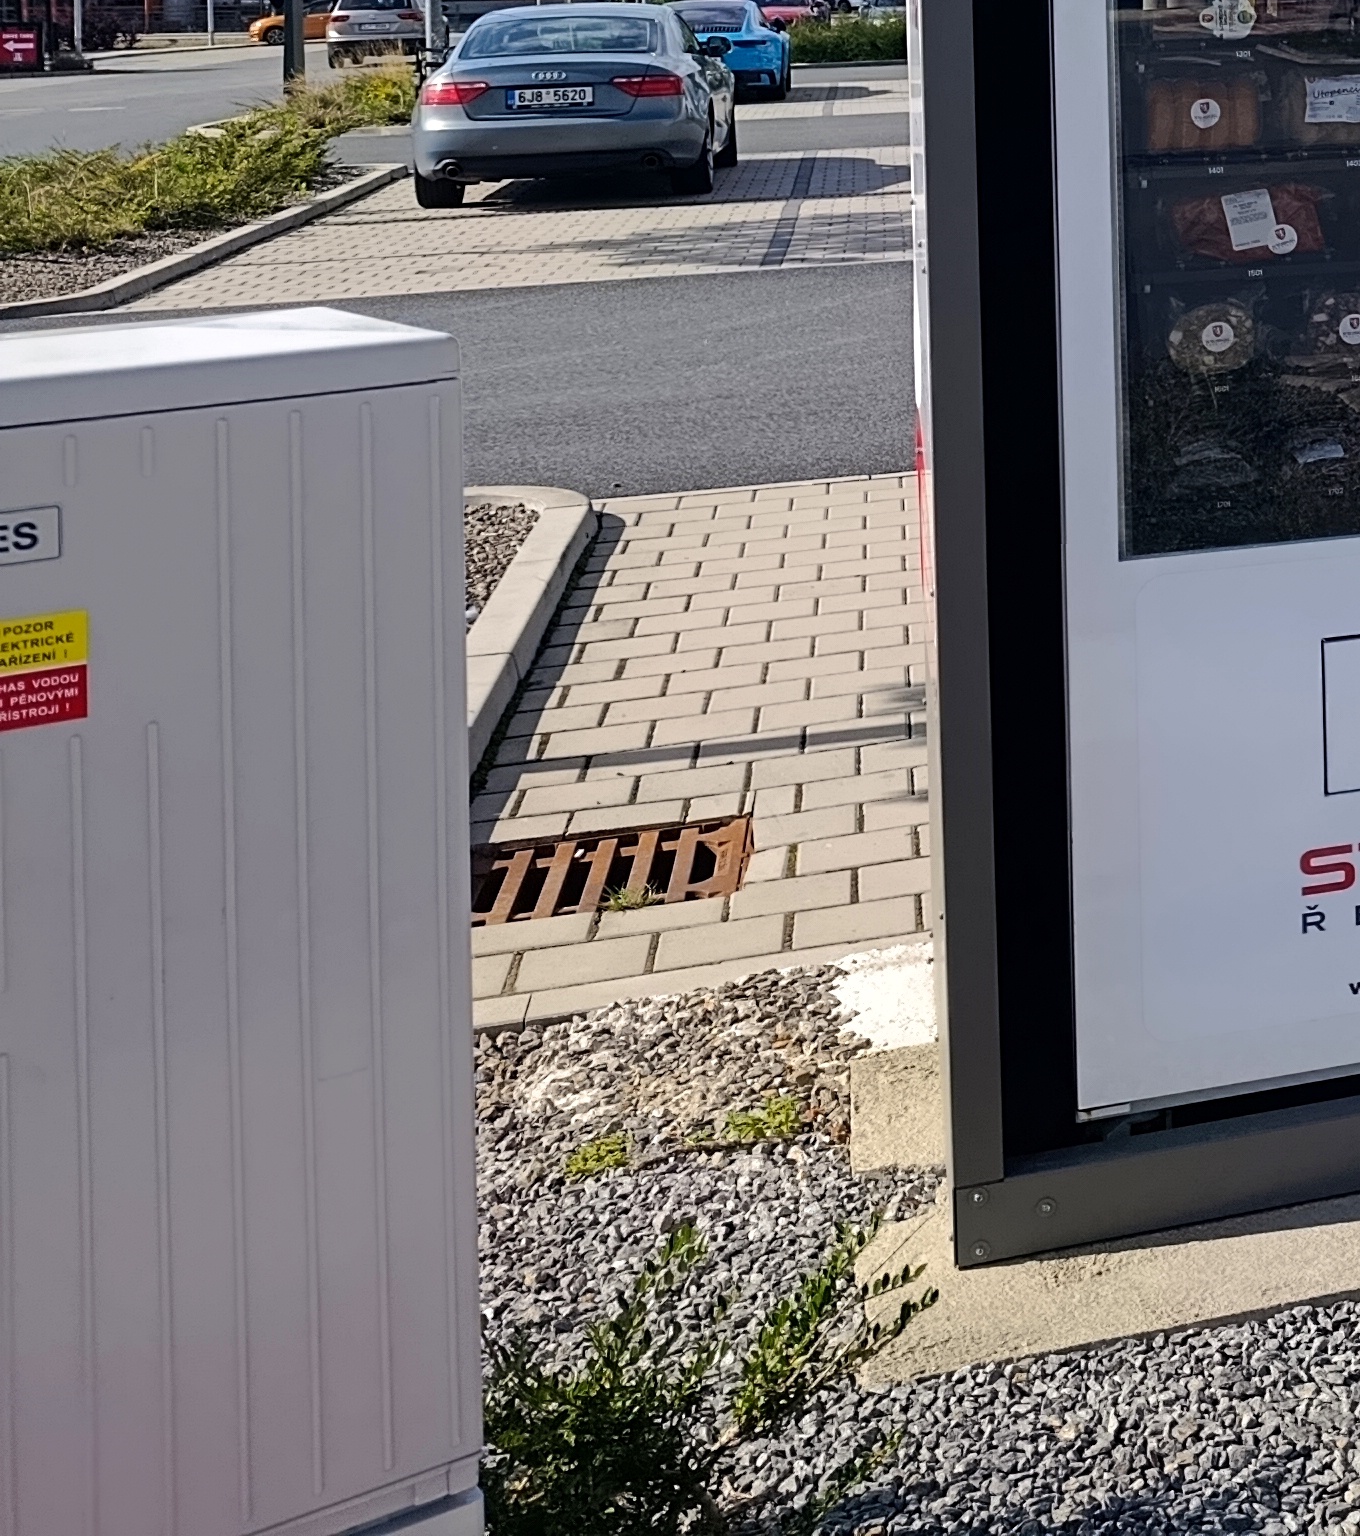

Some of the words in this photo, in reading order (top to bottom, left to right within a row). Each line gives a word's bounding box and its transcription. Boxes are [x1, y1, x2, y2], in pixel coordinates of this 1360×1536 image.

[518, 90, 543, 103] 6J8
[553, 88, 586, 102] 5620
[3, 621, 54, 637] POZOR
[0, 632, 74, 653] EKTRICKÉ
[32, 673, 79, 689] VODOU
[10, 687, 79, 707] PĚNOVÝMI
